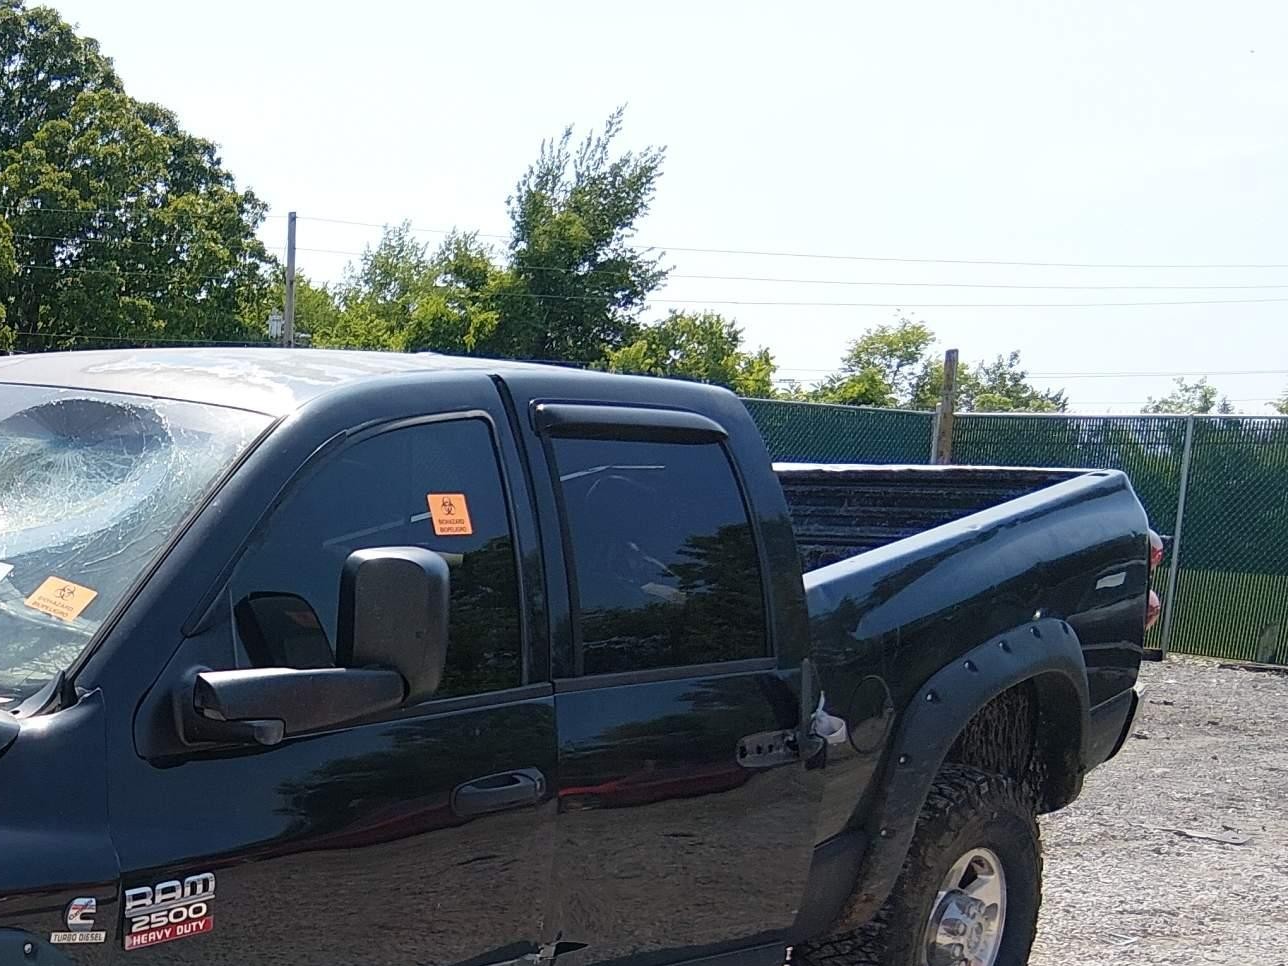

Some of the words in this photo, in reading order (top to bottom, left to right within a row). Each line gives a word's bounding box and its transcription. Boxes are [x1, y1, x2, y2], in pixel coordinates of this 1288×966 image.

[125, 872, 216, 911] RAM
[131, 902, 209, 933] 2500
[53, 933, 77, 943] TURBO
[78, 932, 103, 942] DIESEL
[132, 928, 172, 946] HEAVY
[176, 919, 206, 937] DUTY
